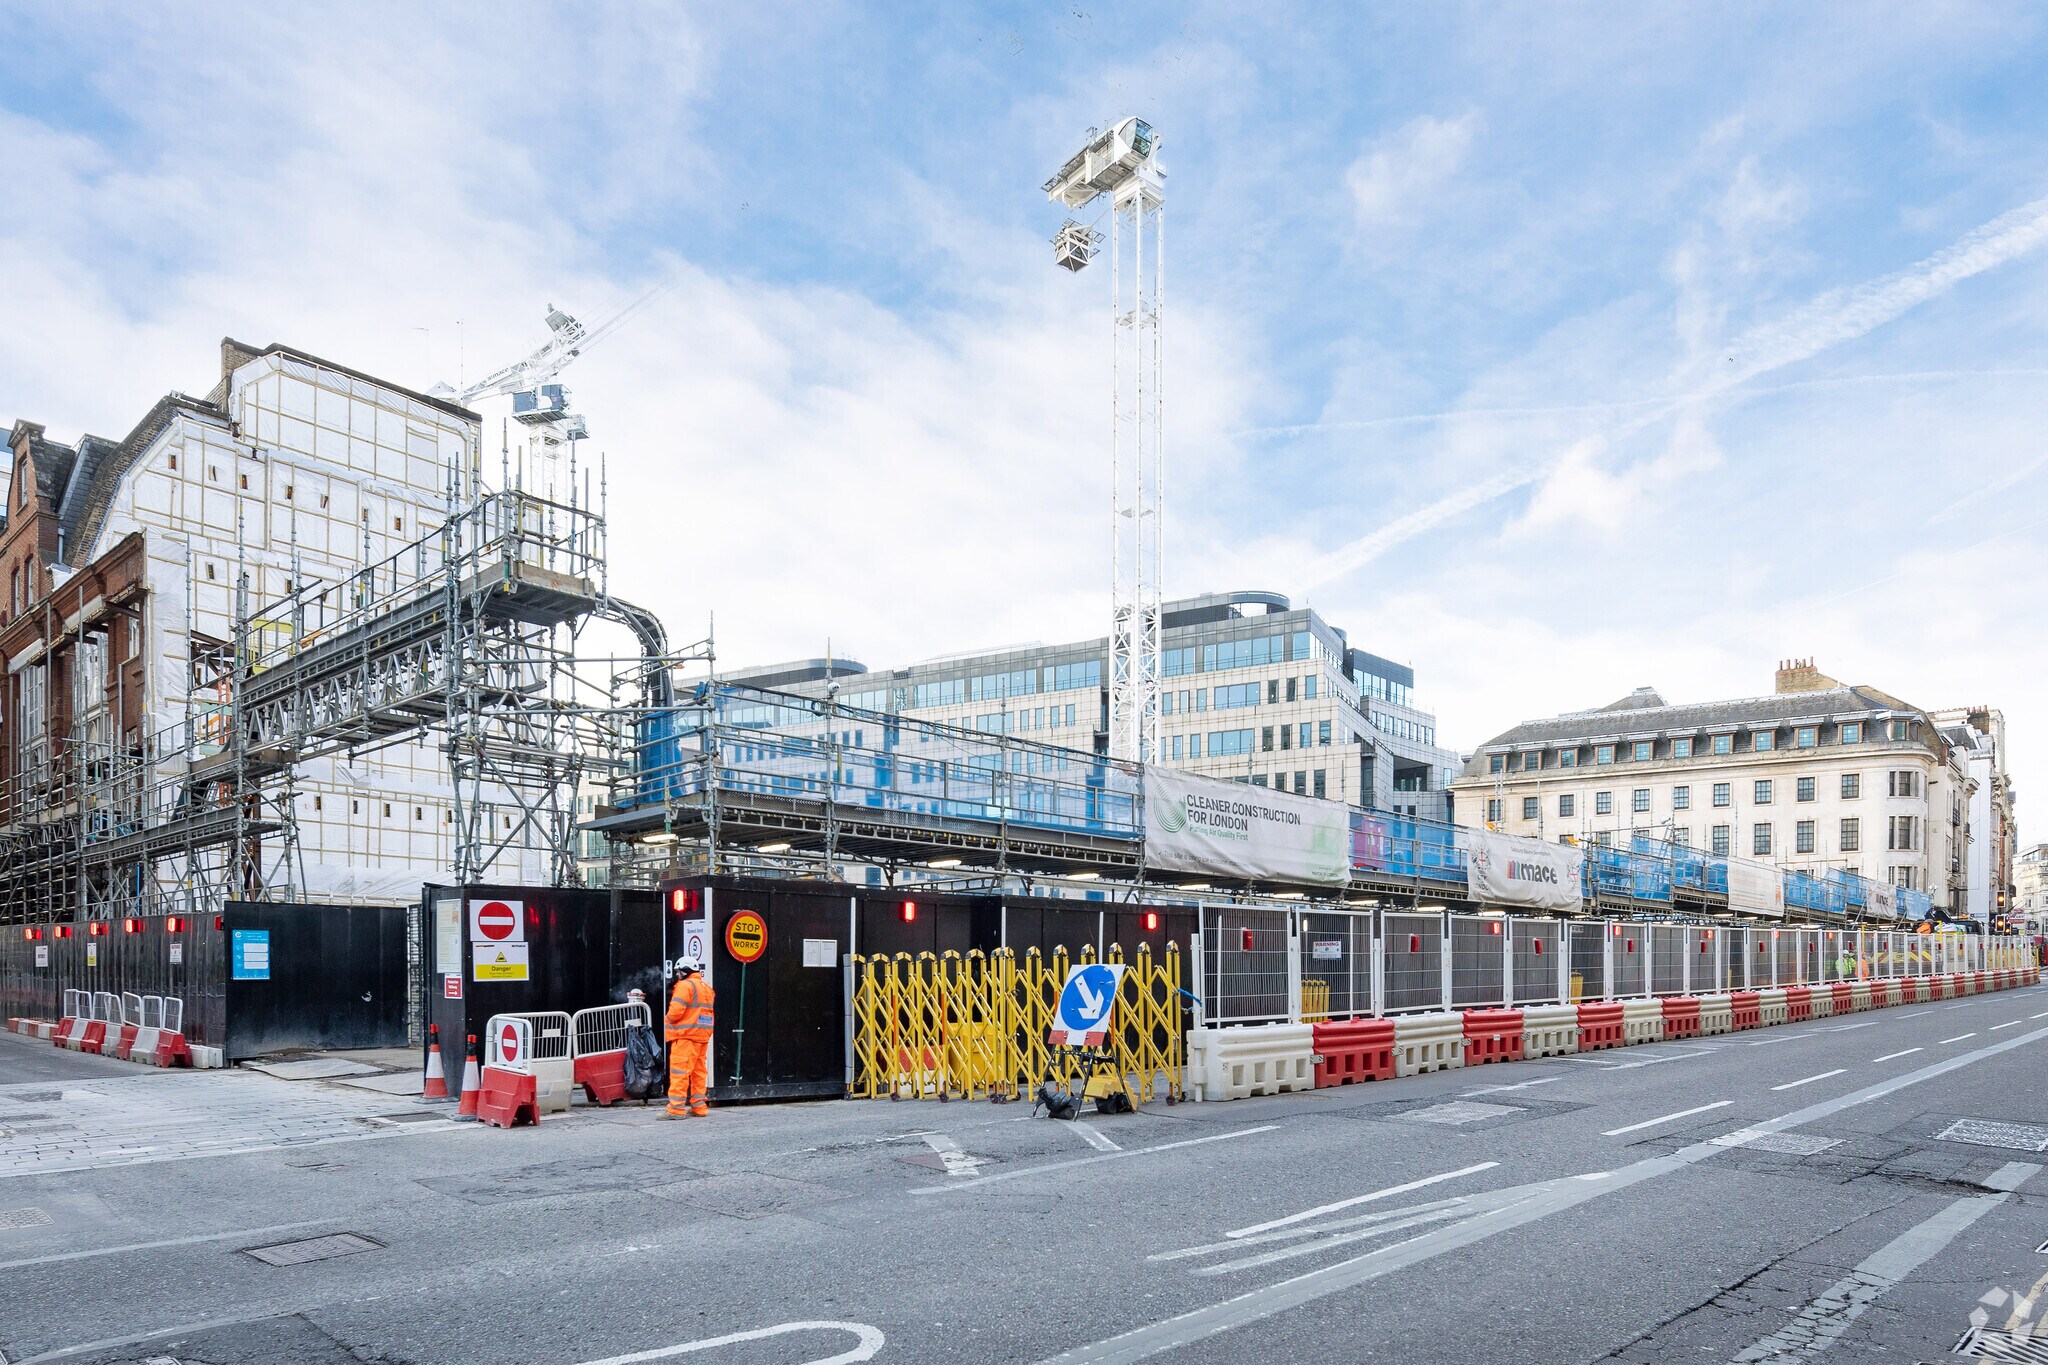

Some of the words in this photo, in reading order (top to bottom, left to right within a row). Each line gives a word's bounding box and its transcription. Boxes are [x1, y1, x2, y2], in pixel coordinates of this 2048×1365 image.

[1187, 794, 1231, 813] CLEANER
[1232, 802, 1301, 825] CONSTRUCTION
[1188, 810, 1207, 825] FOR
[1210, 813, 1248, 831] LONDON
[1218, 829, 1236, 841] Quality
[1237, 832, 1249, 841] First
[1520, 862, 1558, 885] mace
[736, 922, 760, 933] STOP
[692, 940, 698, 952] 5
[733, 940, 760, 950] WORKS
[491, 965, 512, 973] Danger
